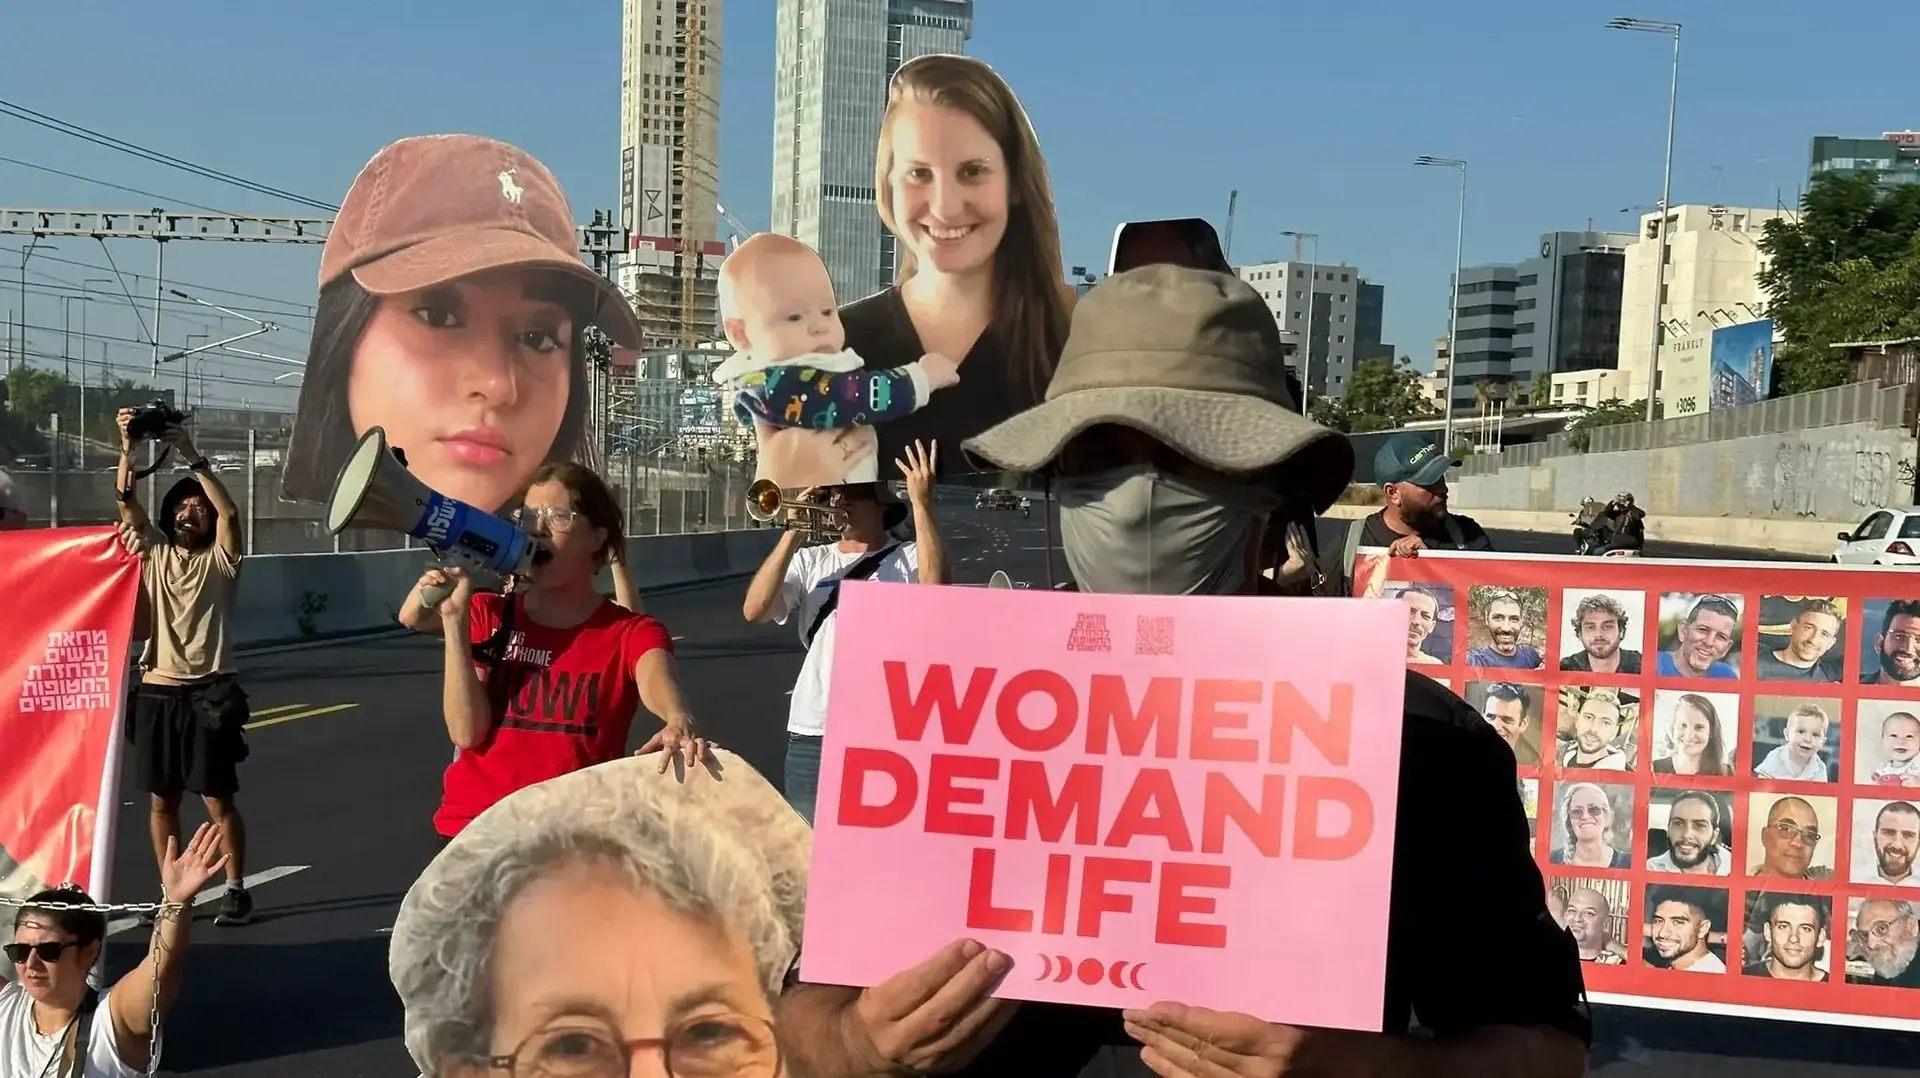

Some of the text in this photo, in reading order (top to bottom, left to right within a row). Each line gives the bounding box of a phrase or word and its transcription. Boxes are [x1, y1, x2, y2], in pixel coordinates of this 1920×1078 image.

[48, 630, 108, 647] מחאת
[45, 645, 109, 663] הנשים
[519, 646, 553, 667] HOME
[28, 661, 109, 681] להחזרת
[22, 677, 109, 696] החטופות
[508, 667, 601, 725] OW!
[19, 693, 110, 713] והחטופים
[883, 660, 1355, 767] WOMEN
[837, 747, 1375, 861] DEMAND
[966, 847, 1232, 949] LIFE
